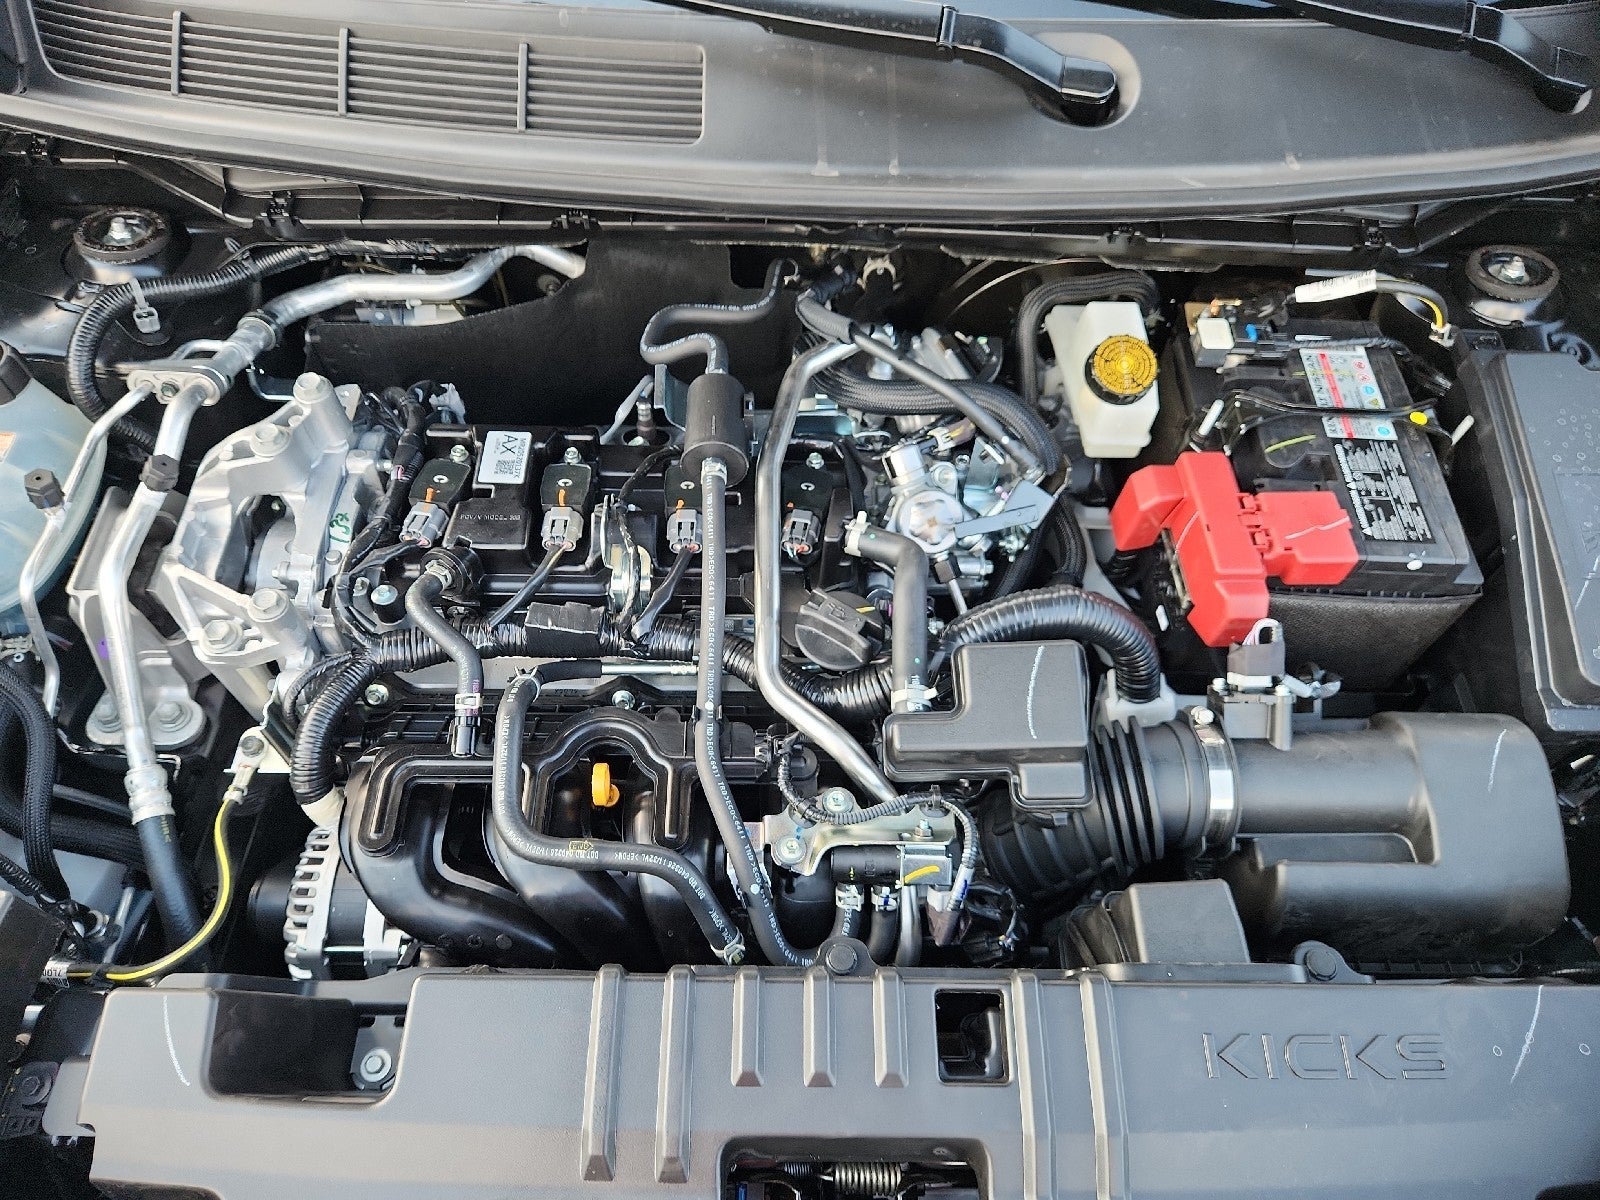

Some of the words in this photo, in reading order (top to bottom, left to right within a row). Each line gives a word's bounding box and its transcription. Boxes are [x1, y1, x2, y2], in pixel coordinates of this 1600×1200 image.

[499, 434, 518, 455] AX
[707, 542, 716, 601] TRD>ECO<6411
[707, 605, 716, 666] TRD>ECO<6411
[706, 668, 714, 722] TRD>ECO<11
[706, 722, 721, 778] TRD>ECO<6411
[718, 781, 746, 840] TRD>ECO<6411
[1202, 1032, 1452, 1080] KICKS
